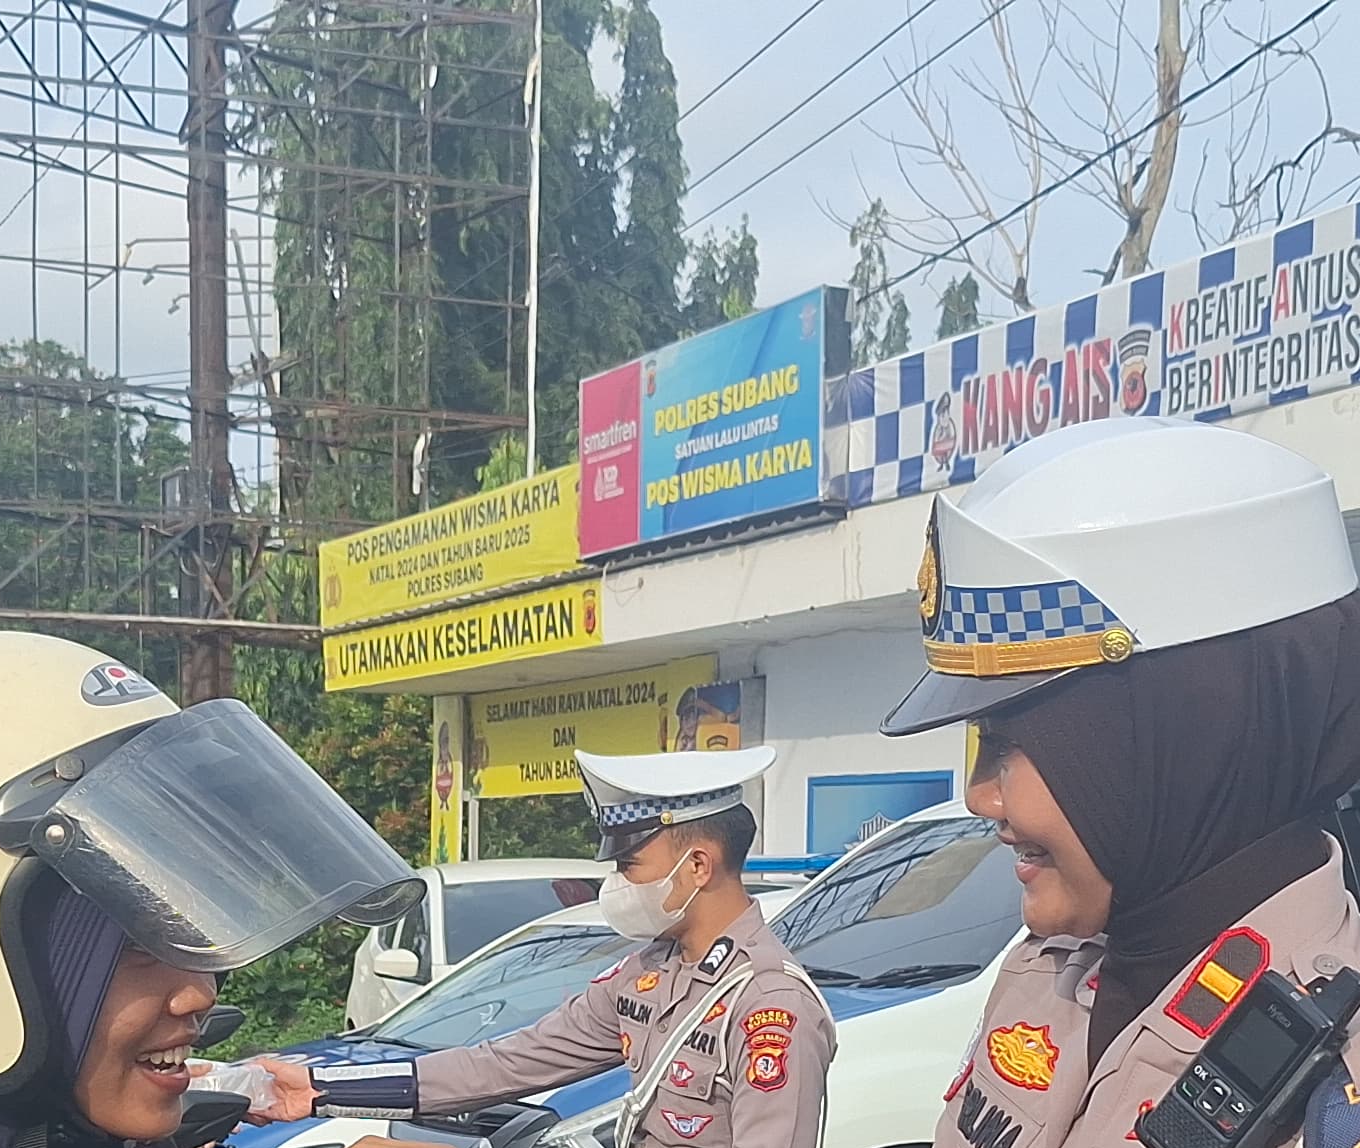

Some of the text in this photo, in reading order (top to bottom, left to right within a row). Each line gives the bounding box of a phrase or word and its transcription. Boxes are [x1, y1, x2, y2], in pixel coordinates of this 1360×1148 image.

[1168, 274, 1268, 354] KREATIF
[1167, 313, 1360, 416] BERINTEGRITAS
[653, 363, 800, 436] POLRES SUBANG
[961, 337, 1112, 456] KANG AIS
[583, 419, 638, 455] smartfren
[674, 414, 780, 460] SATUAN LALU LINTAS
[646, 474, 681, 509] POS
[680, 458, 744, 500] WISMA
[745, 438, 813, 483] KARYA
[347, 541, 369, 566] POS
[371, 511, 457, 559] PENGAMANAN
[460, 495, 507, 532] WISMA
[511, 479, 560, 518] KARYA
[369, 524, 531, 585] NATAL 2024 DAN TAHUN BARU 2025
[407, 563, 484, 599] POLRES SUBANG
[339, 597, 574, 678] UTAMAKAN KESELAMATAN
[486, 680, 656, 723] SELAMAT HARI RAYA NATAL 2024
[553, 726, 576, 748] DAN
[519, 761, 553, 783] TAHUN
[1193, 1064, 1209, 1081] OK
